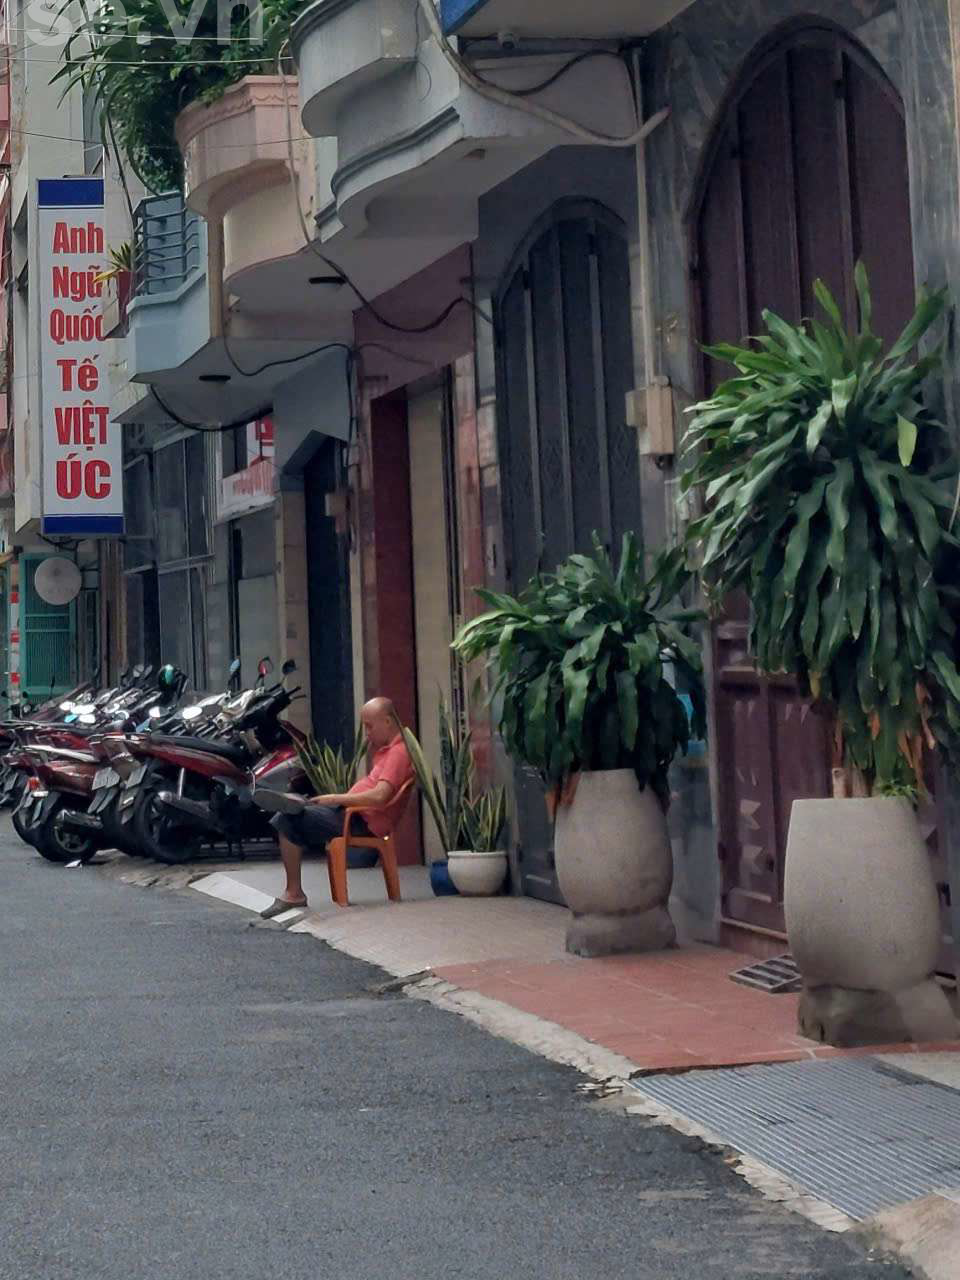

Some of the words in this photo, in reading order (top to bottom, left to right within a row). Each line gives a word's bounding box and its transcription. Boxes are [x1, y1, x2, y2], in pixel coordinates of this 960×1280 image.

[52, 221, 104, 255] Anh
[49, 304, 106, 345] Quốc
[56, 354, 100, 392] Tế
[54, 400, 110, 452] VIỆT
[55, 452, 112, 500] ÚC
